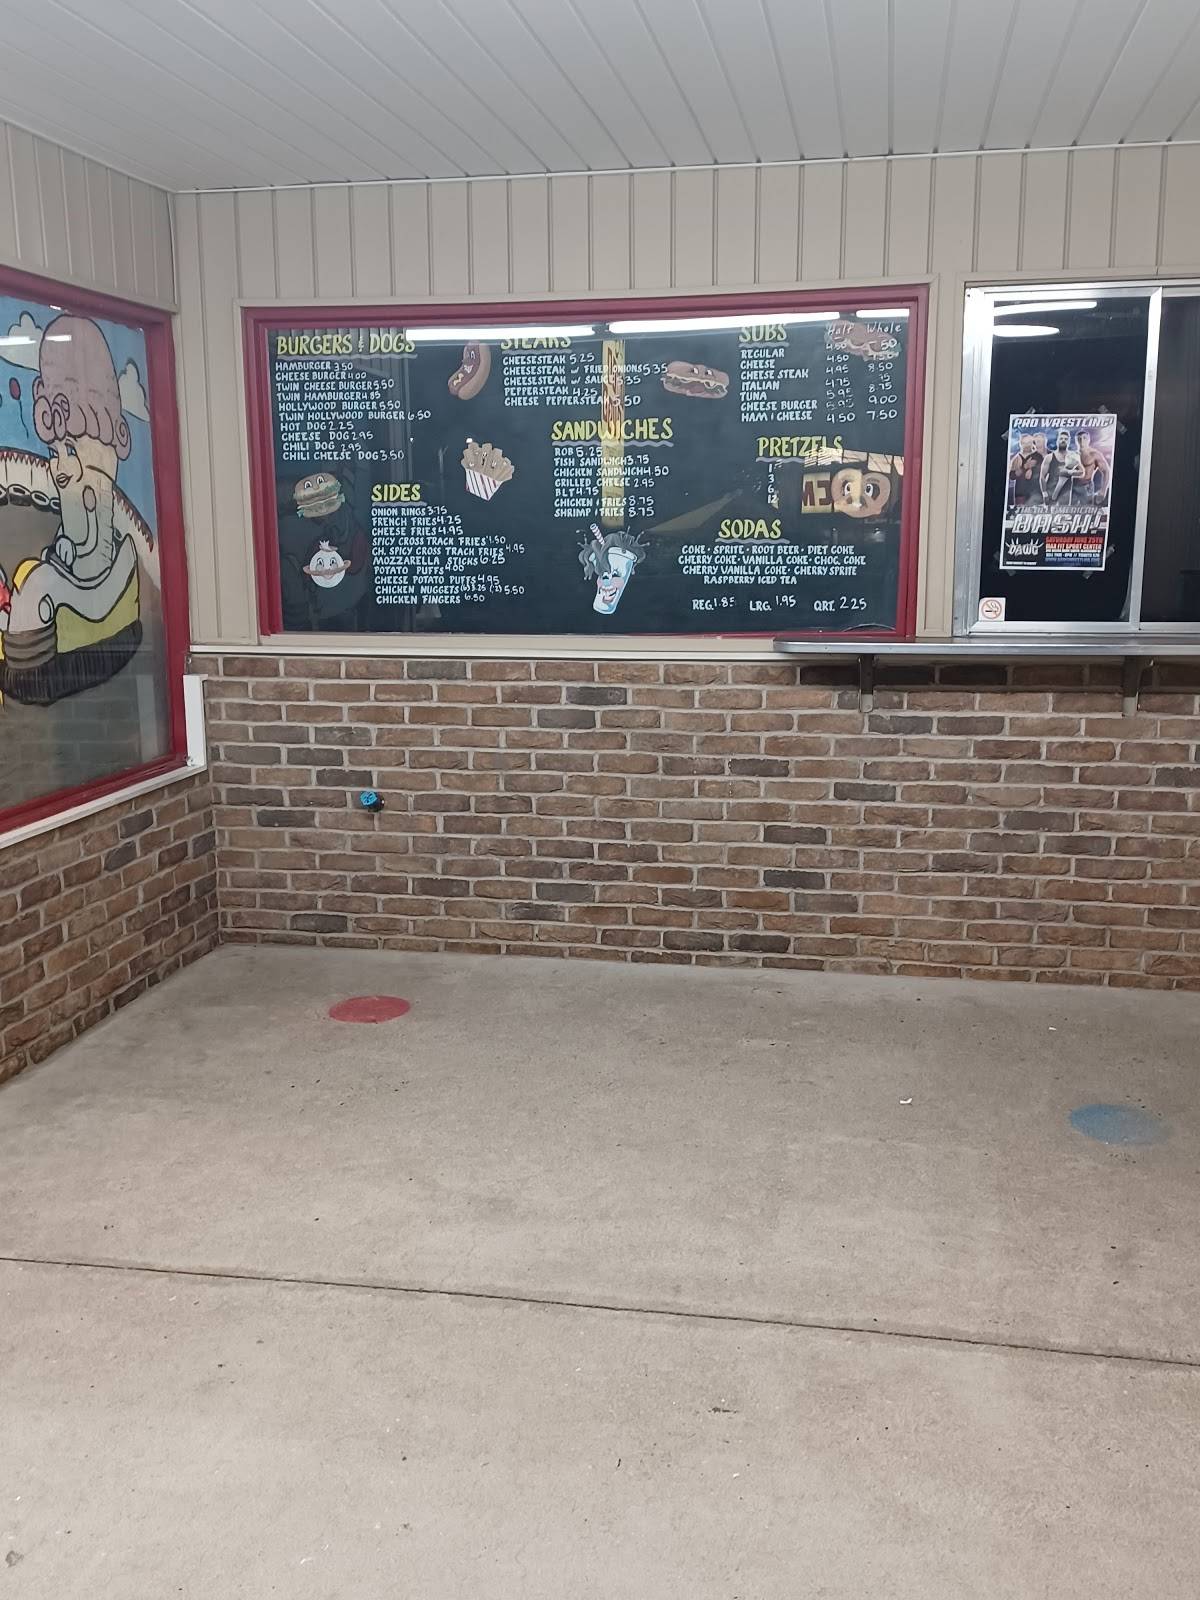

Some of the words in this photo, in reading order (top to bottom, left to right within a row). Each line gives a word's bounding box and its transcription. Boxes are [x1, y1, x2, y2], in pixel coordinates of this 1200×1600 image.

[738, 324, 788, 342] SUBS
[276, 334, 353, 355] BURGERS
[369, 333, 416, 353] DOGS
[740, 348, 785, 358] REGULAR
[503, 355, 566, 365] CHEESESTEAK
[740, 359, 776, 369] CHEESE
[276, 361, 331, 371] HAMBURGER
[504, 366, 566, 376] CHEESESTEAK
[276, 372, 310, 380] CHEESE
[312, 371, 346, 380] BURGER
[740, 370, 775, 380] CHEESE
[777, 368, 809, 378] STEAK
[276, 382, 300, 392] TWIN
[304, 381, 336, 390] CHEESE
[338, 380, 372, 390] BURGER
[504, 376, 566, 386] CHEESESTEAK
[742, 380, 780, 391] ITALIAN
[504, 386, 568, 396] PEPPERSTEAK
[276, 392, 300, 402] TWIN
[304, 391, 362, 400] HAMBURGER
[504, 396, 539, 406] CHEESE
[546, 396, 610, 406] PEPPERSTEAK
[740, 391, 768, 402] TUNA
[278, 402, 336, 412] HOLLYWOOD
[342, 401, 378, 410] BURGER
[740, 401, 778, 411] CHEESE
[780, 400, 818, 410] BURGER
[279, 412, 304, 421] TWIN
[308, 411, 364, 420] HOLLYWOOD
[368, 410, 405, 420] BURGER
[742, 412, 768, 422] HAM
[776, 410, 813, 421] CHEESE
[280, 422, 300, 432] HOT
[307, 422, 326, 430] DOG
[1013, 417, 1040, 428] PRO
[551, 418, 673, 440] SANDWICHES
[282, 432, 320, 441] CHEESE
[329, 431, 350, 440] DOG
[283, 442, 310, 451] CHILI
[315, 441, 335, 450] DOG
[283, 452, 310, 460] CHILI
[314, 451, 352, 460] CHEESE
[358, 451, 378, 460] DOG
[554, 458, 575, 466] FISH
[579, 456, 627, 466] SANDWICH
[554, 468, 592, 477] CHICKEN
[596, 467, 644, 476] SANDWICH
[554, 478, 592, 487] GRILLED
[596, 478, 630, 487] CHEESE
[768, 474, 774, 483] 3
[372, 484, 421, 502] SIDES
[555, 488, 575, 497] BLT
[768, 484, 775, 493] 6
[554, 498, 593, 507] CHICKEN
[602, 498, 626, 507] FRIES
[371, 508, 398, 516] ONION
[401, 508, 426, 516] RINGS
[554, 508, 592, 518] SHRIMP
[600, 507, 624, 516] FRIES
[372, 517, 408, 526] FRENCH
[411, 517, 436, 526] FRIES
[372, 527, 406, 536] CHEESE
[410, 527, 436, 536] FRIES
[718, 519, 782, 539] SODAS
[372, 536, 396, 546] SPICY
[398, 536, 424, 546] CROSS
[426, 536, 454, 546] TRACK
[458, 537, 486, 546] FRIES
[372, 546, 386, 556] CH.
[389, 546, 413, 556] SPICY
[416, 546, 442, 556] CROSS
[478, 547, 504, 558] FRIES
[682, 544, 706, 554] COKE
[712, 545, 744, 554] SPRITE
[751, 545, 775, 554] ROOT
[777, 545, 800, 554] BEER
[808, 545, 828, 554] DIET
[830, 545, 854, 554] COKE
[372, 556, 440, 566] MOZZARELLA
[446, 556, 478, 566] STICKS
[678, 555, 712, 564] CHERRY
[714, 555, 737, 564] COKE
[742, 555, 783, 564] VANILLA
[786, 555, 808, 564] COKE
[844, 556, 866, 565] COKE
[374, 566, 409, 575] POTATO
[416, 566, 444, 575] PUFFS
[682, 566, 718, 575] CHERRY
[720, 566, 760, 574] VANILLA
[764, 566, 787, 575] COKE
[794, 566, 828, 576] CHERRY
[828, 566, 858, 576] SPRITE
[374, 576, 409, 585] CHEESE
[412, 575, 445, 584] POTATO
[450, 575, 476, 585] PUFFS
[704, 576, 755, 585] RASPBERRY
[758, 576, 778, 584] ICED
[780, 576, 798, 585] TEA
[375, 585, 415, 594] CHICKEN
[420, 585, 460, 594] NUGGETS
[376, 595, 418, 604] CHICKEN
[422, 595, 461, 604] FINGERS
